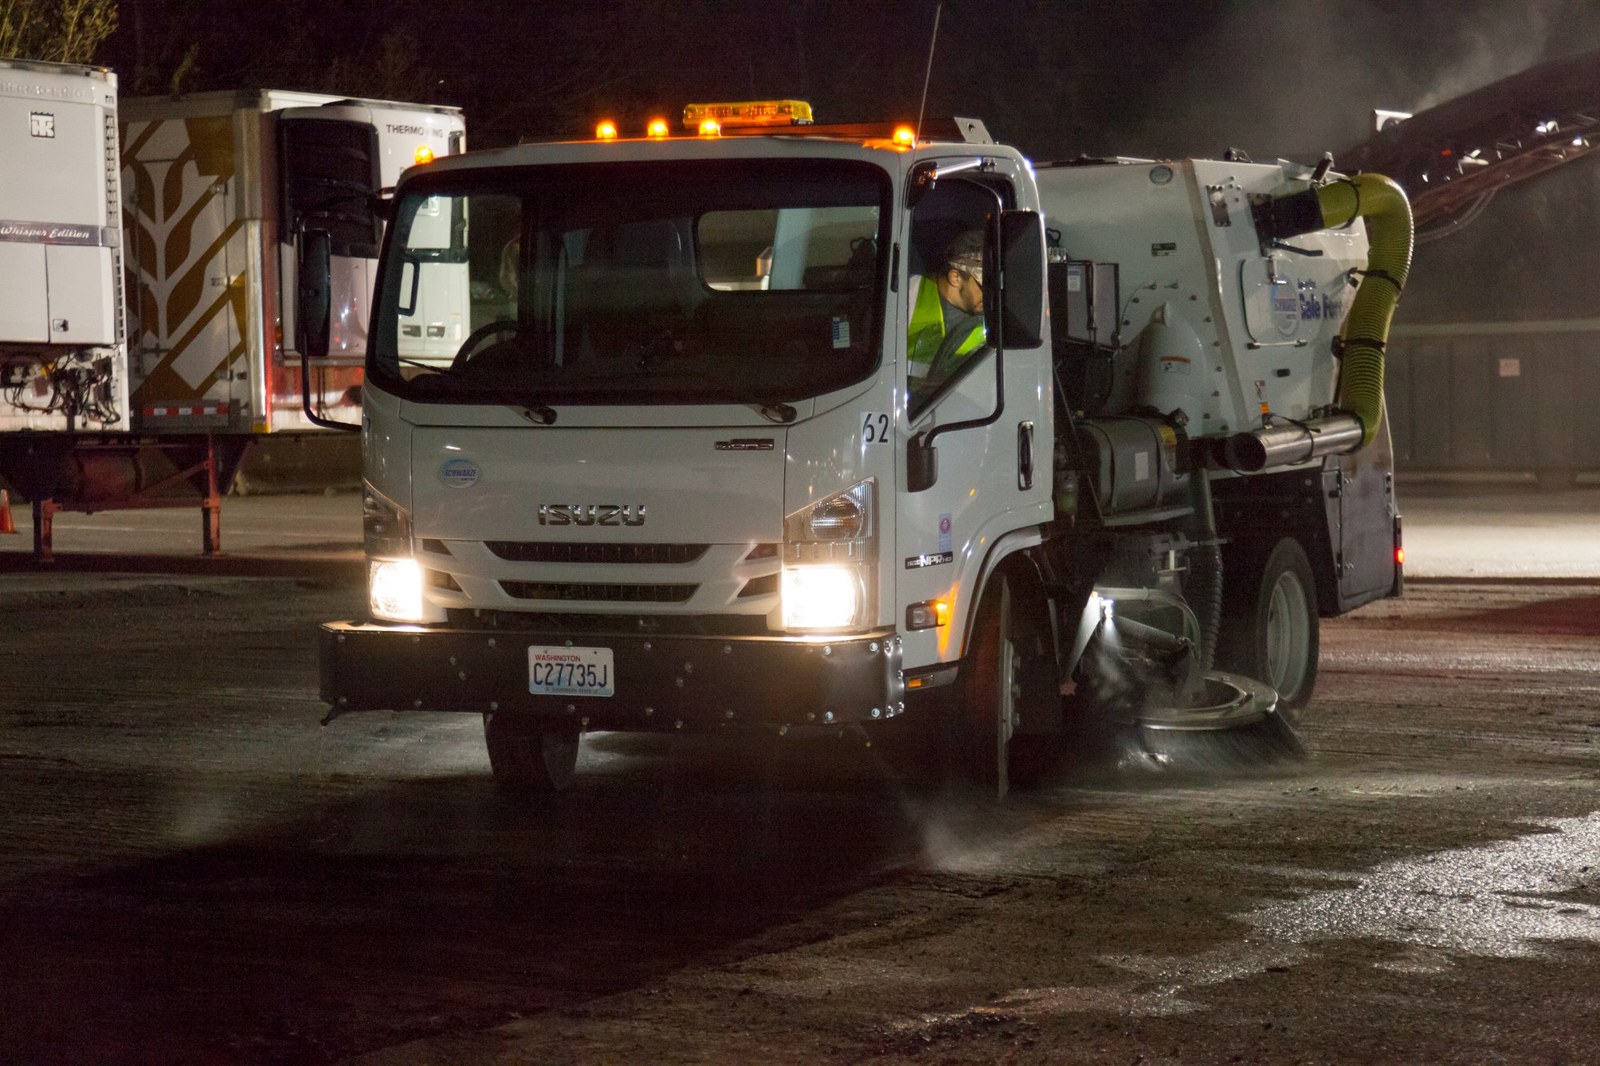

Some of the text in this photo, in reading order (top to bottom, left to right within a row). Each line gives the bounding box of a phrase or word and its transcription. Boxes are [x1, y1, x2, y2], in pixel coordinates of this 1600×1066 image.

[386, 124, 424, 137] THERMO
[0, 226, 89, 239] Whisper Edition
[862, 413, 889, 443] 62
[538, 504, 646, 526] ISUZU
[920, 554, 943, 567] NPR
[534, 654, 581, 662] WASHINGTON
[534, 662, 607, 688] C27735J
